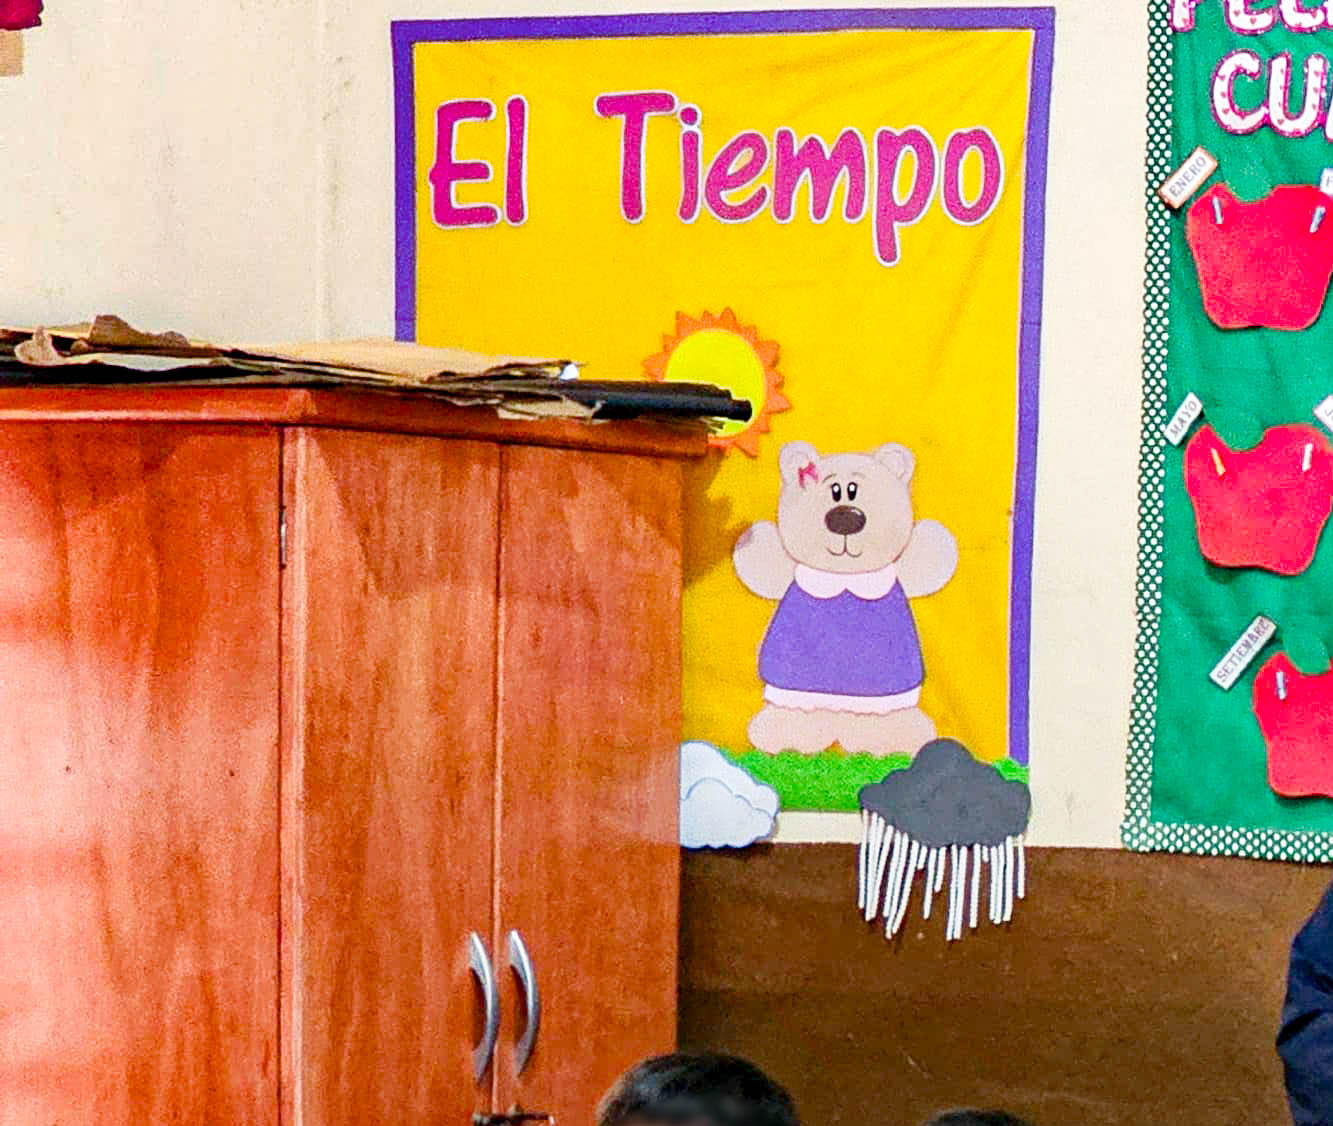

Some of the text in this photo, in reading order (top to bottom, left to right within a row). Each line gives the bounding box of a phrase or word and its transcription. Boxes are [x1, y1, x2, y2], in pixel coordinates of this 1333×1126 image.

[430, 91, 1004, 266] El Tiempo
[1168, 156, 1206, 197] ENERO
[1169, 400, 1198, 438] MAYO
[1217, 619, 1270, 682] SETIEMBRE
